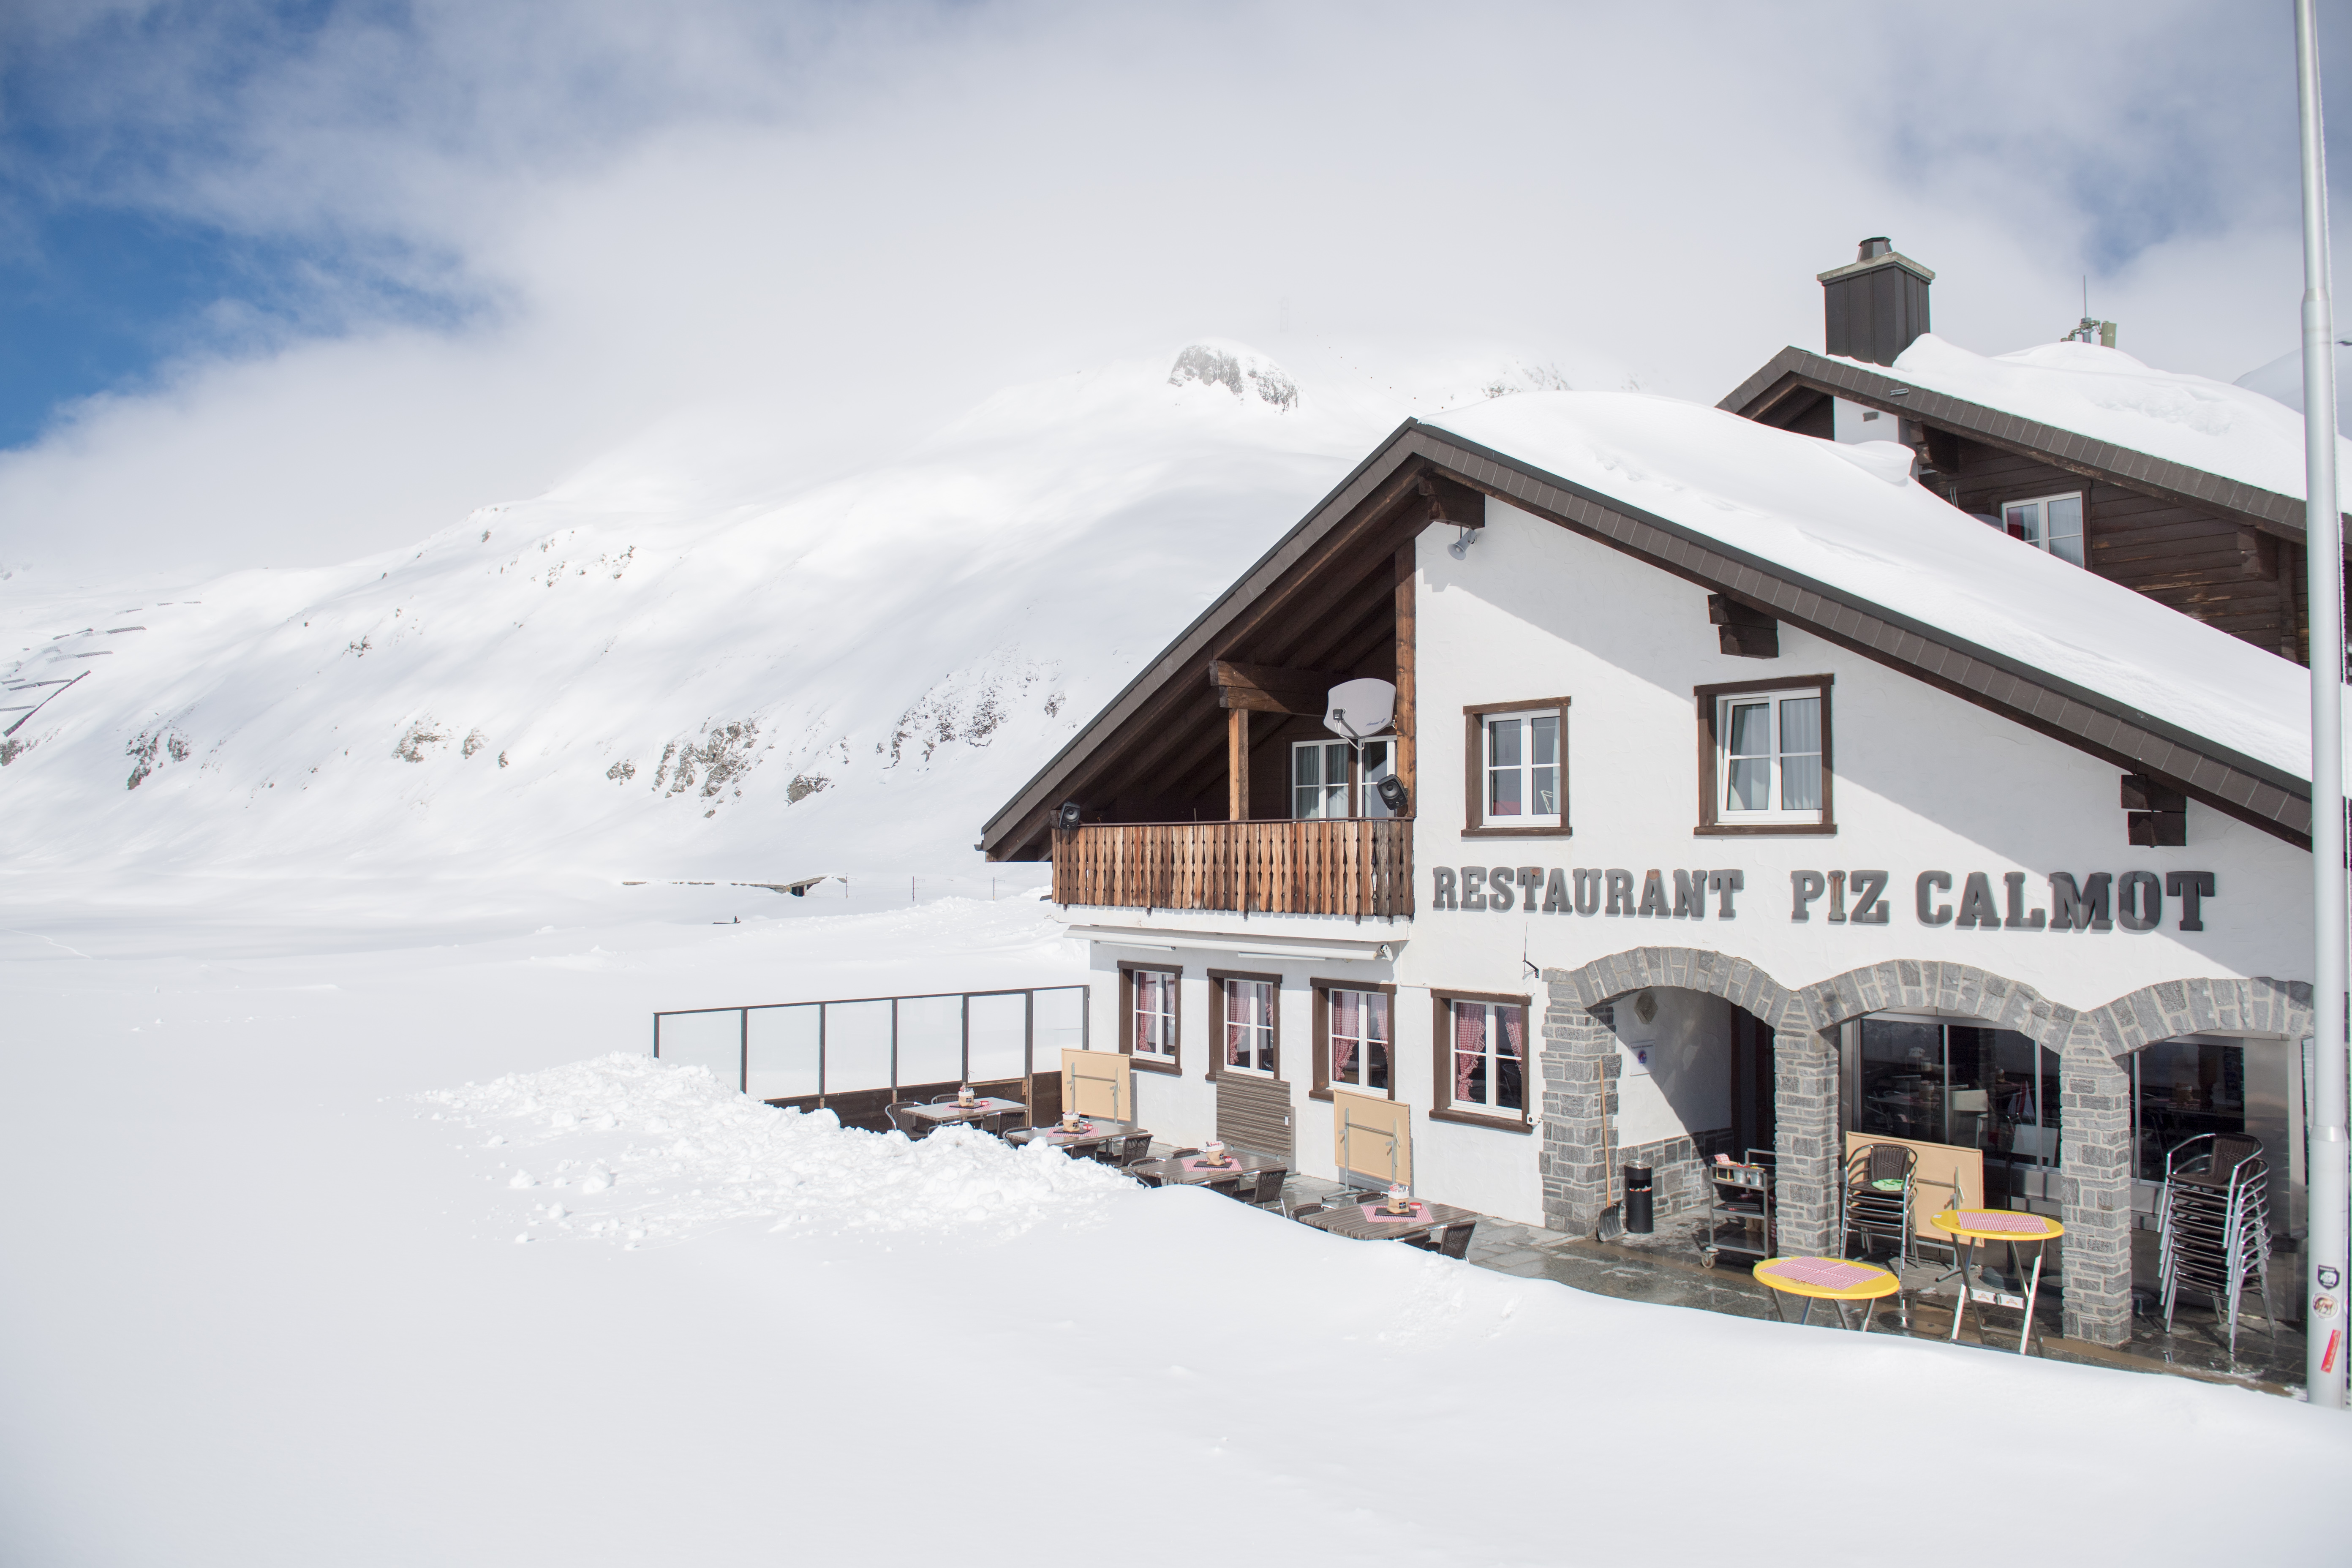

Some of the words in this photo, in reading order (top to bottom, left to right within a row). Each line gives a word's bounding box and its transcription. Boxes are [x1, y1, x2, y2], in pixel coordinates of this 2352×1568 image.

[1432, 866, 1744, 919] RESTAURANT
[1790, 870, 1889, 924] PIZ
[1914, 870, 2215, 932] CALMOT
